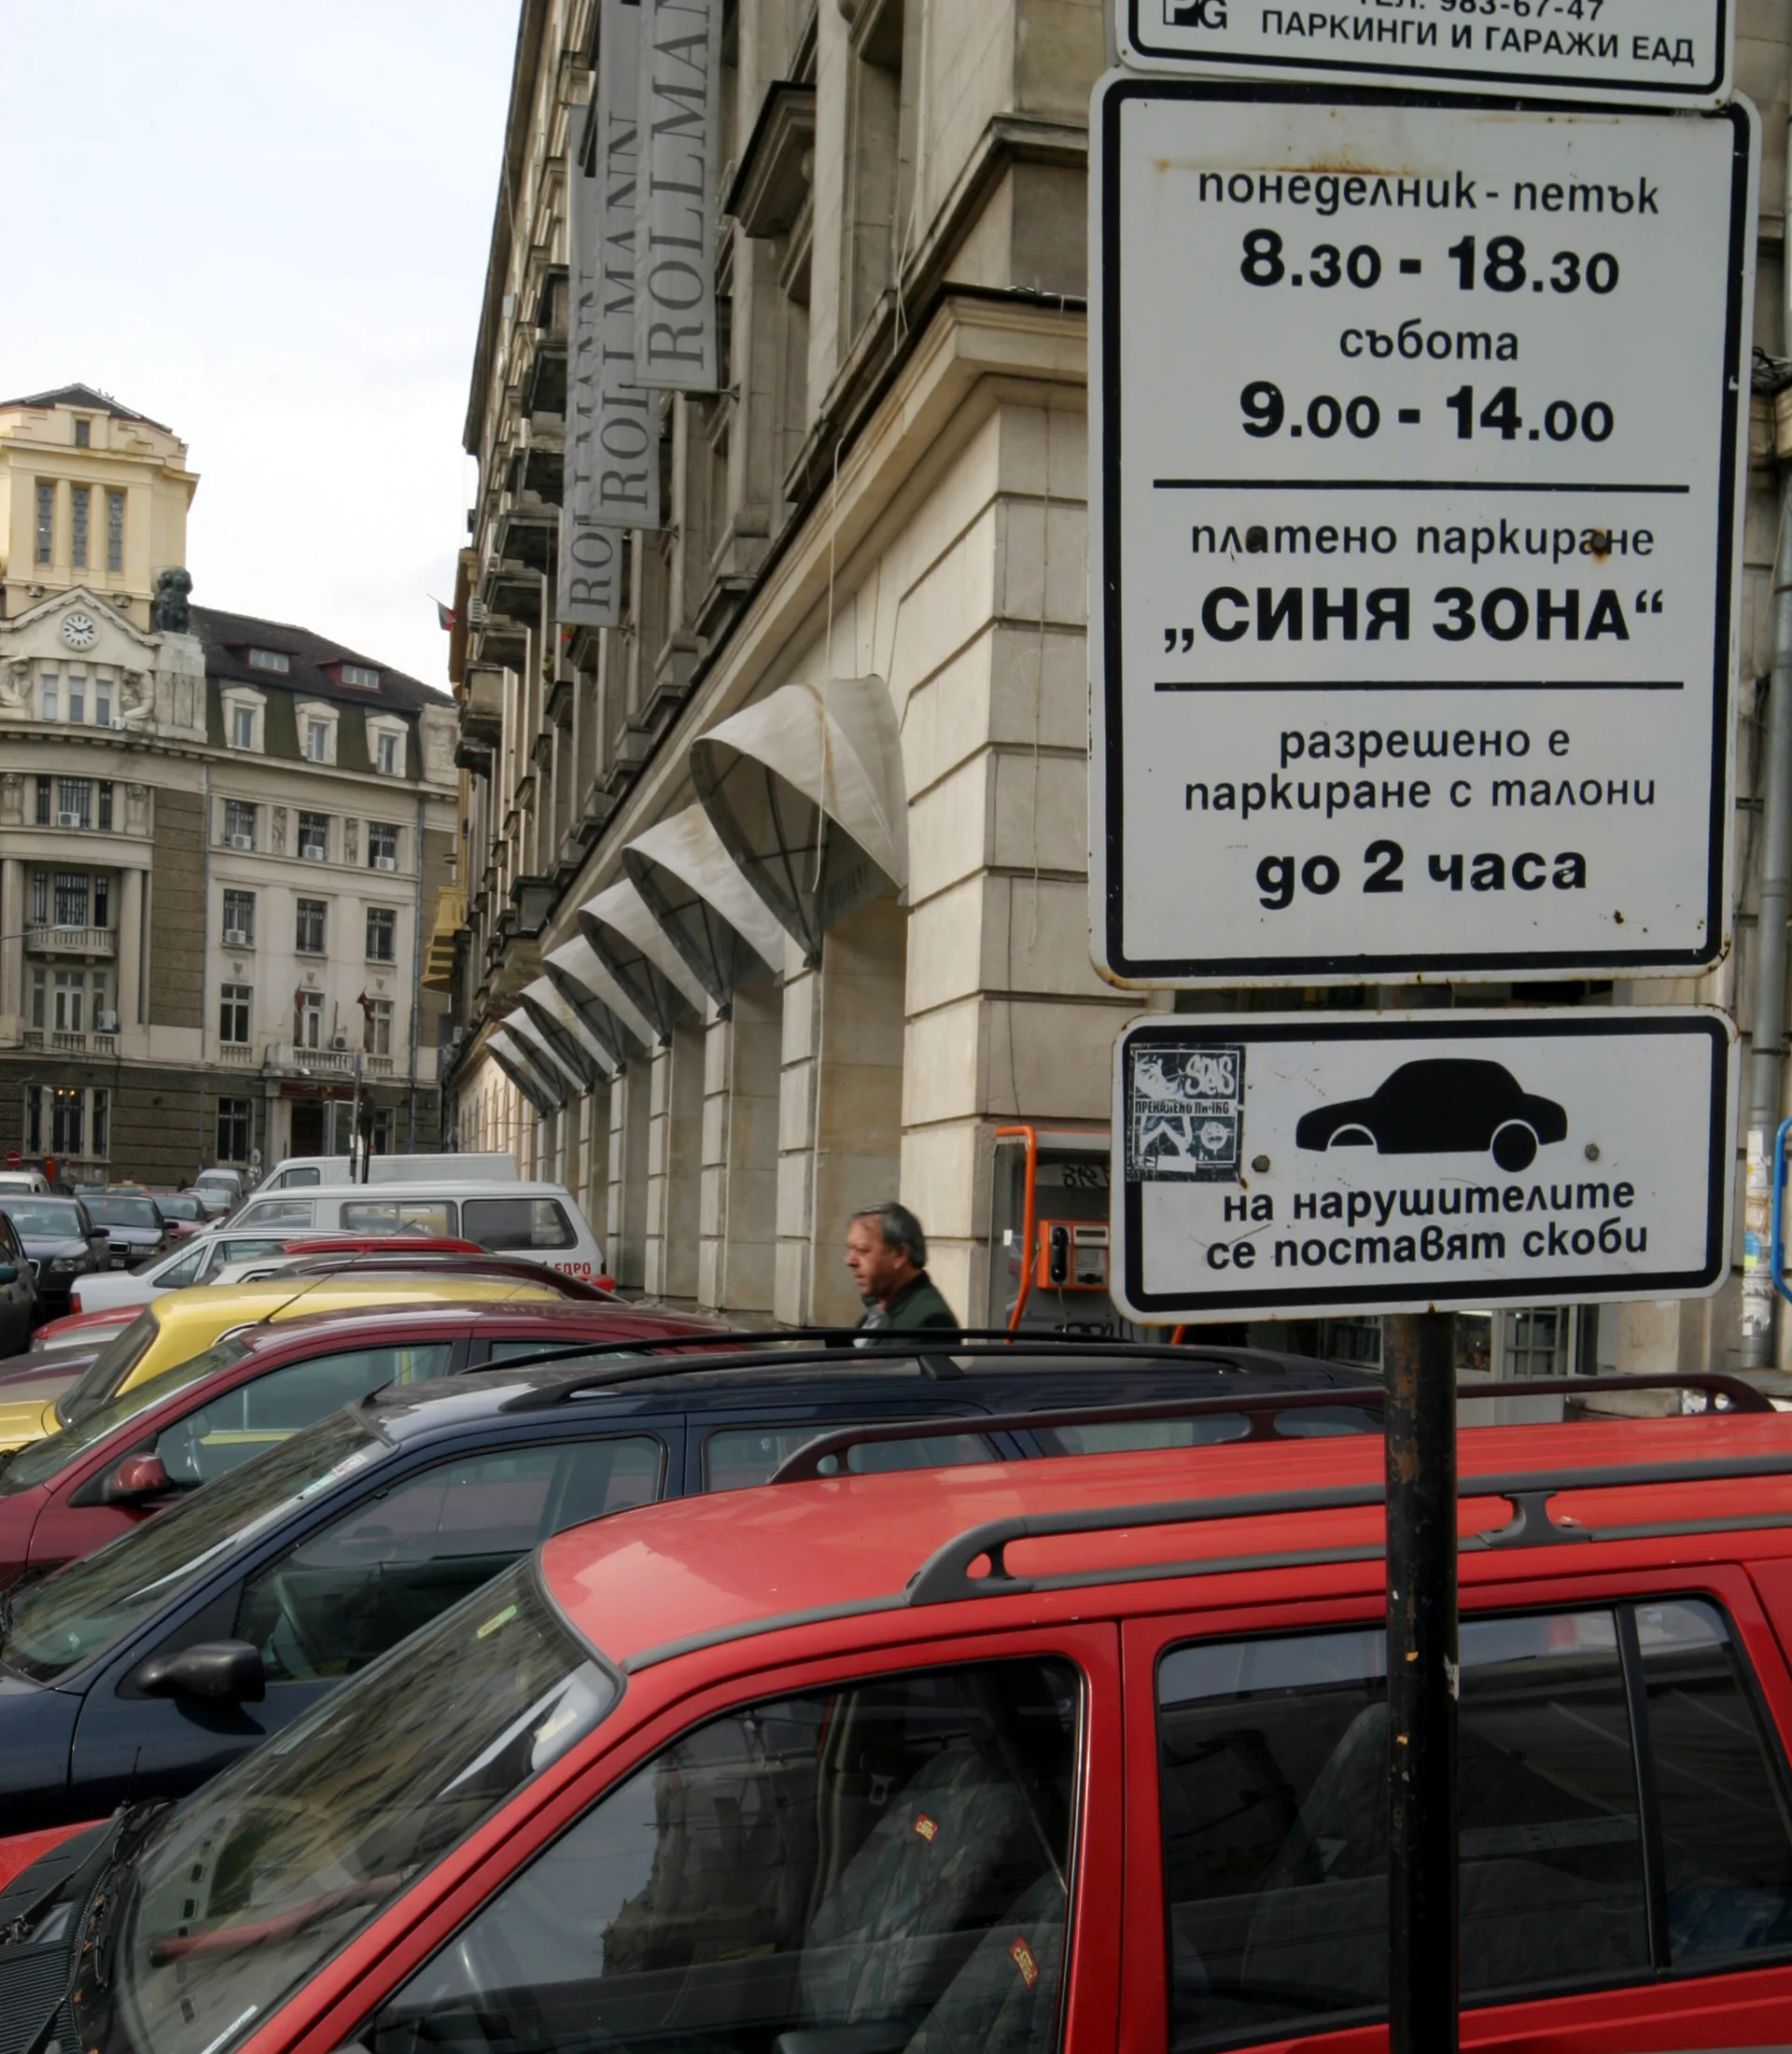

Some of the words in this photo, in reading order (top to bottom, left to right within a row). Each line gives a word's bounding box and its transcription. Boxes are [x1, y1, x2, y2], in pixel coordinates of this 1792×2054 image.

[1262, 9, 1437, 47] ПАРКИНГИ
[1451, 23, 1472, 49] И
[1485, 26, 1618, 59] ГАРАЖИ
[1632, 35, 1695, 68] ЕАД
[1199, 171, 1477, 217] понеделник
[1514, 176, 1659, 215] петък
[1239, 228, 1382, 289] 8.30
[1448, 234, 1619, 295] 18.30
[1339, 317, 1519, 361] събота
[1239, 380, 1380, 440] 9.00
[1446, 384, 1615, 443] 14.00
[1192, 525, 1397, 554] платено
[1417, 518, 1654, 565] паркиране
[1280, 729, 1531, 769] разрешено
[1548, 729, 1570, 757] е
[1185, 773, 1431, 820] паркиране
[1449, 779, 1472, 808] с
[1491, 779, 1655, 807] талони
[1255, 855, 1340, 911] до
[1363, 839, 1405, 894] 2
[1428, 851, 1587, 892] часа
[1224, 1194, 1274, 1223] на
[1294, 1181, 1635, 1227] нарушителите
[1206, 1241, 1256, 1270] се
[1275, 1227, 1505, 1267] поставят
[1522, 1216, 1647, 1258] скоби
